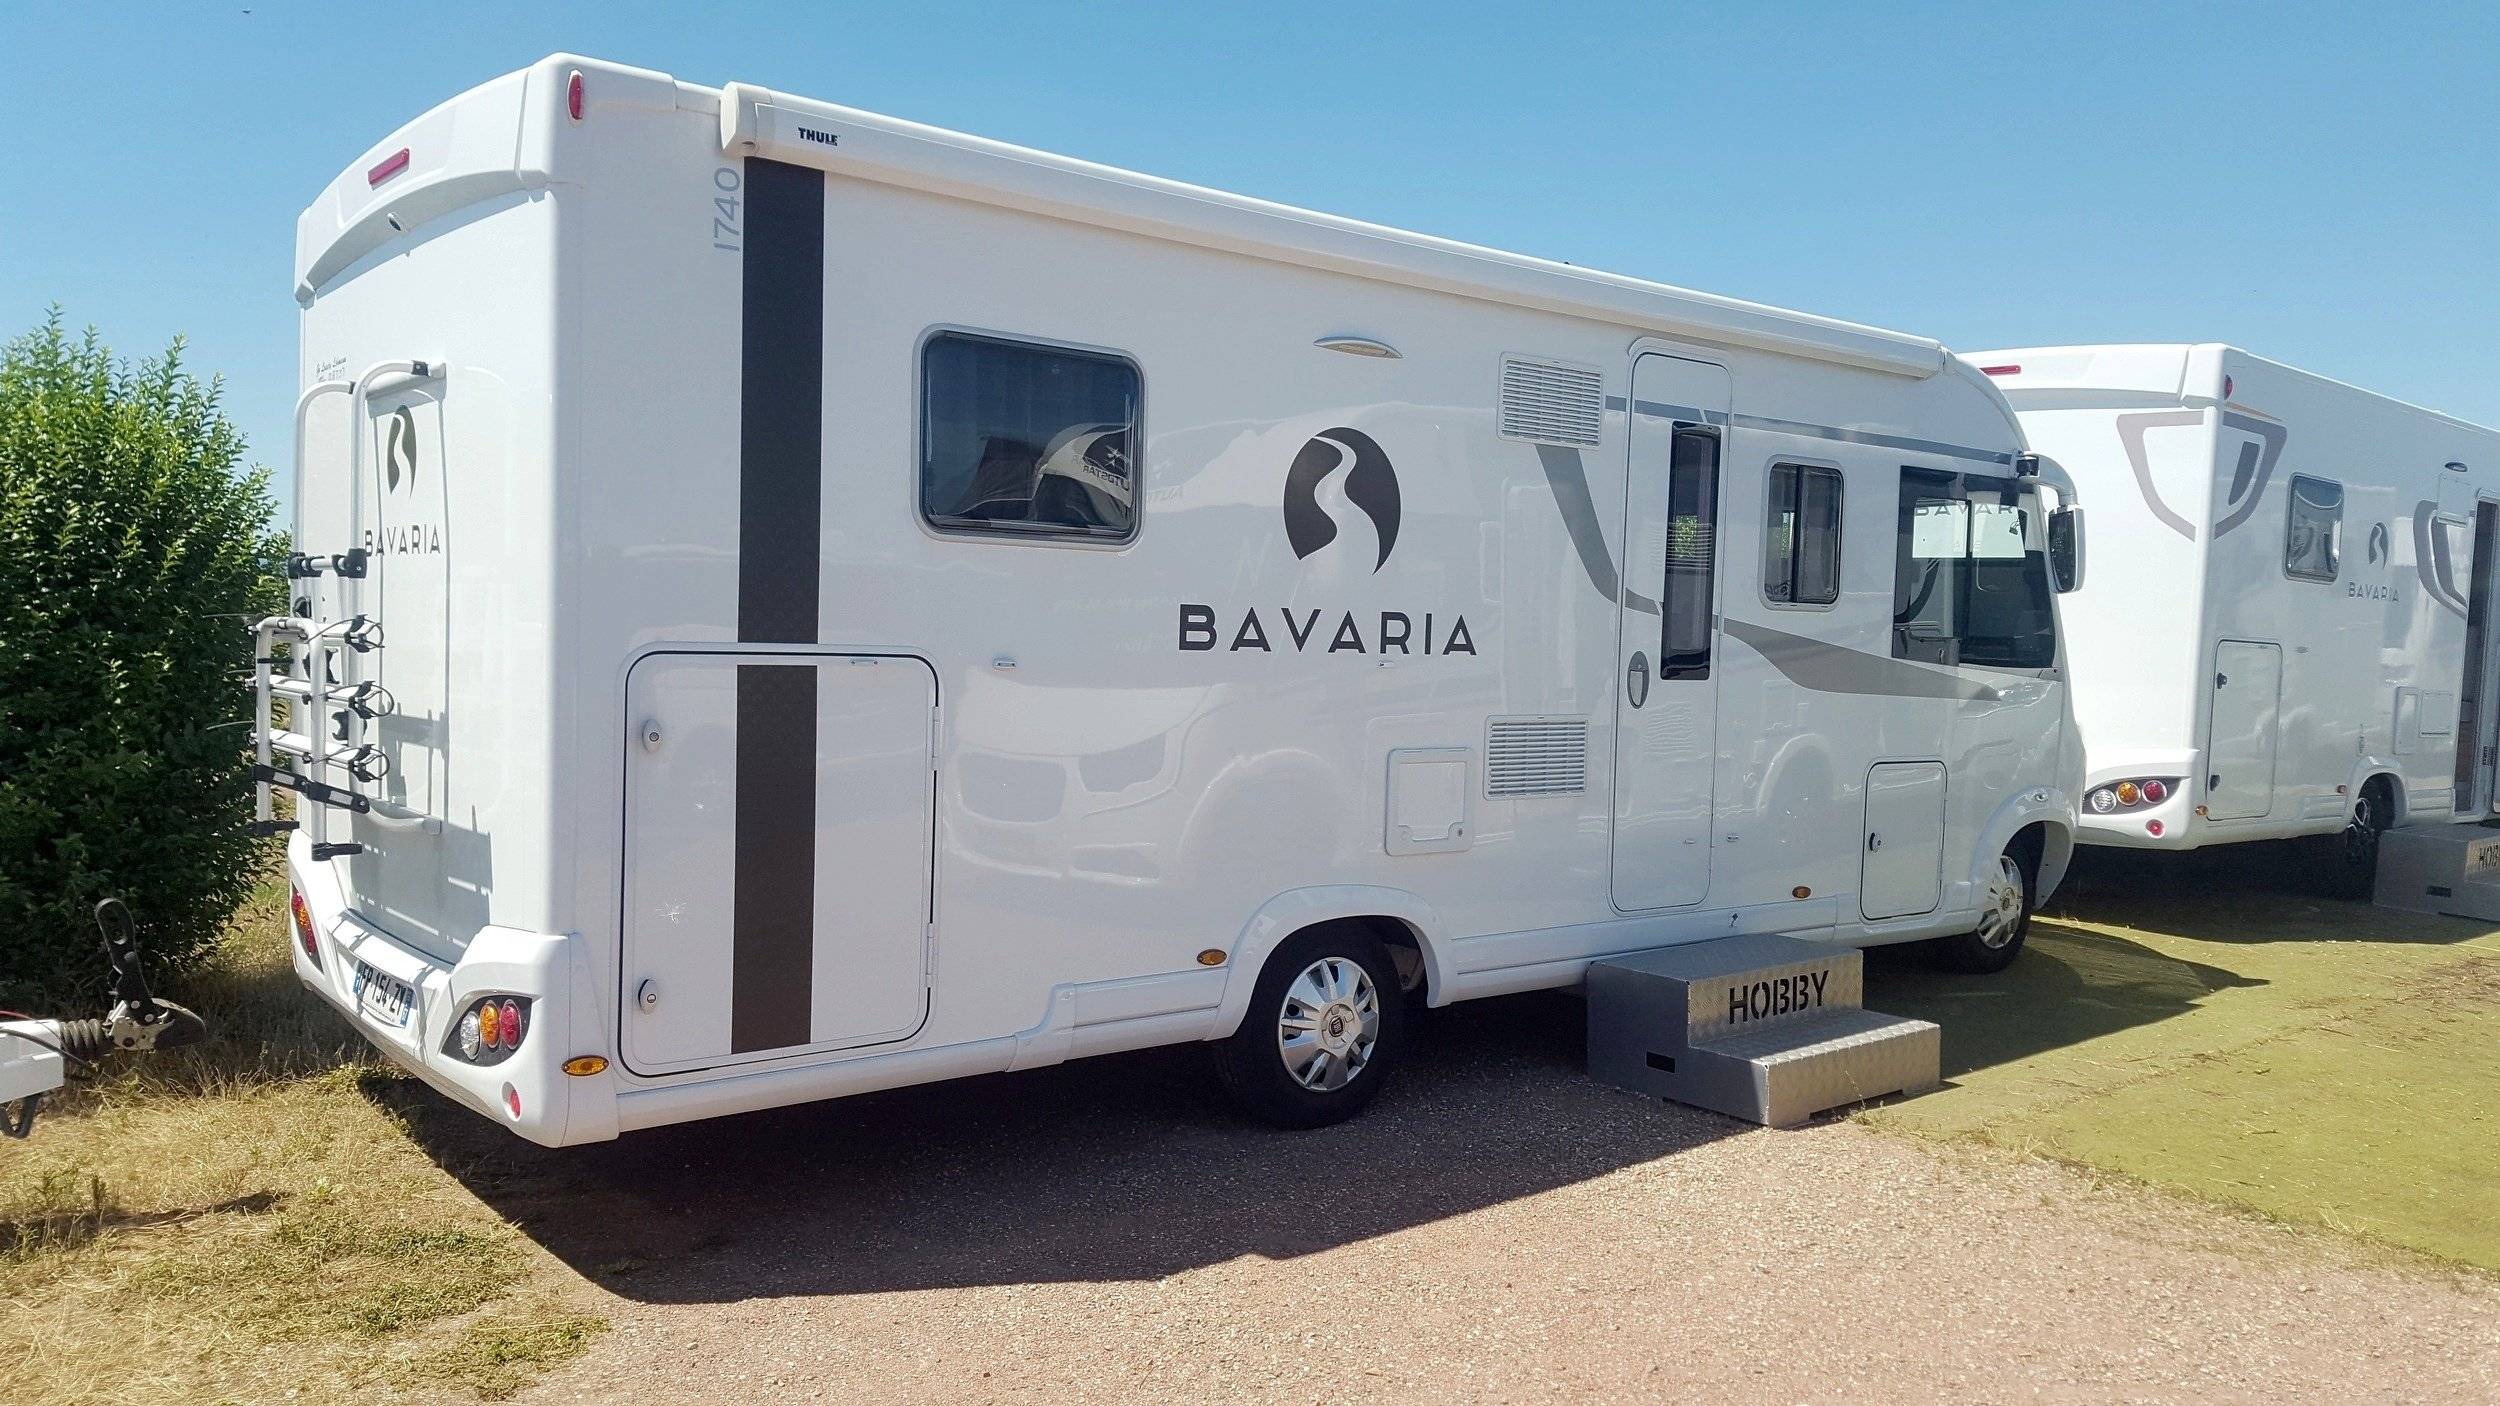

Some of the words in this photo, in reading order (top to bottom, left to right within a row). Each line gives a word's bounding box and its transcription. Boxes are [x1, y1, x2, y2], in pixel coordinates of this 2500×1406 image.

[798, 127, 839, 146] THULE
[713, 167, 741, 252] 1740
[364, 524, 441, 557] BAVARIA
[2347, 582, 2400, 602] BAVARIA
[1178, 603, 1477, 656] BAVARIA
[1729, 970, 1829, 1025] HOBBY
